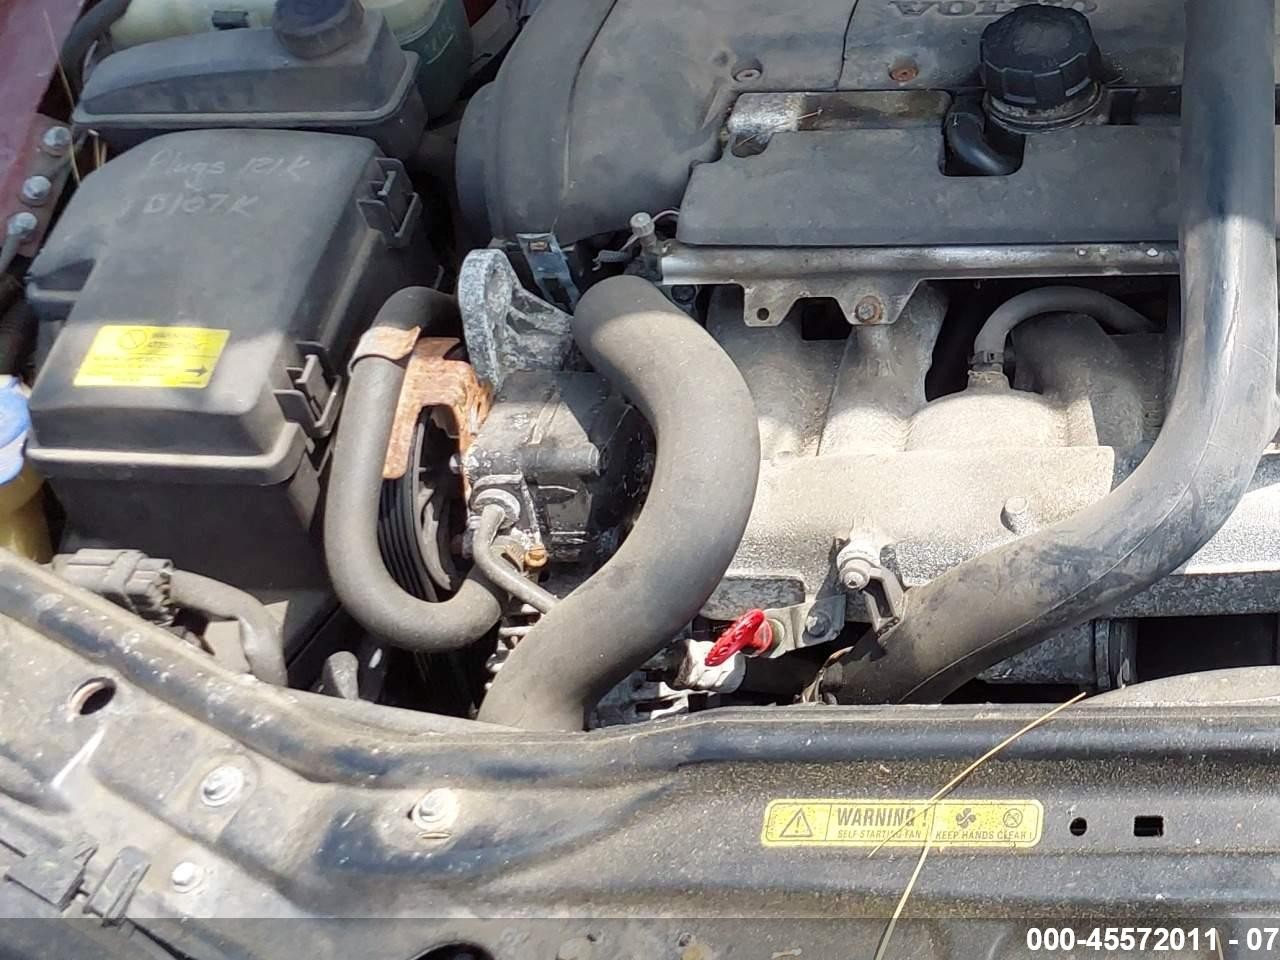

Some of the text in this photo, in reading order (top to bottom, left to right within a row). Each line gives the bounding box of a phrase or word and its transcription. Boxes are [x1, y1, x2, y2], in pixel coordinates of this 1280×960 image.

[888, 0, 1098, 16] VOLO
[837, 807, 917, 827] WARNING
[837, 829, 858, 839] SELF
[935, 830, 961, 840] KEEP
[963, 830, 994, 840] HANDS
